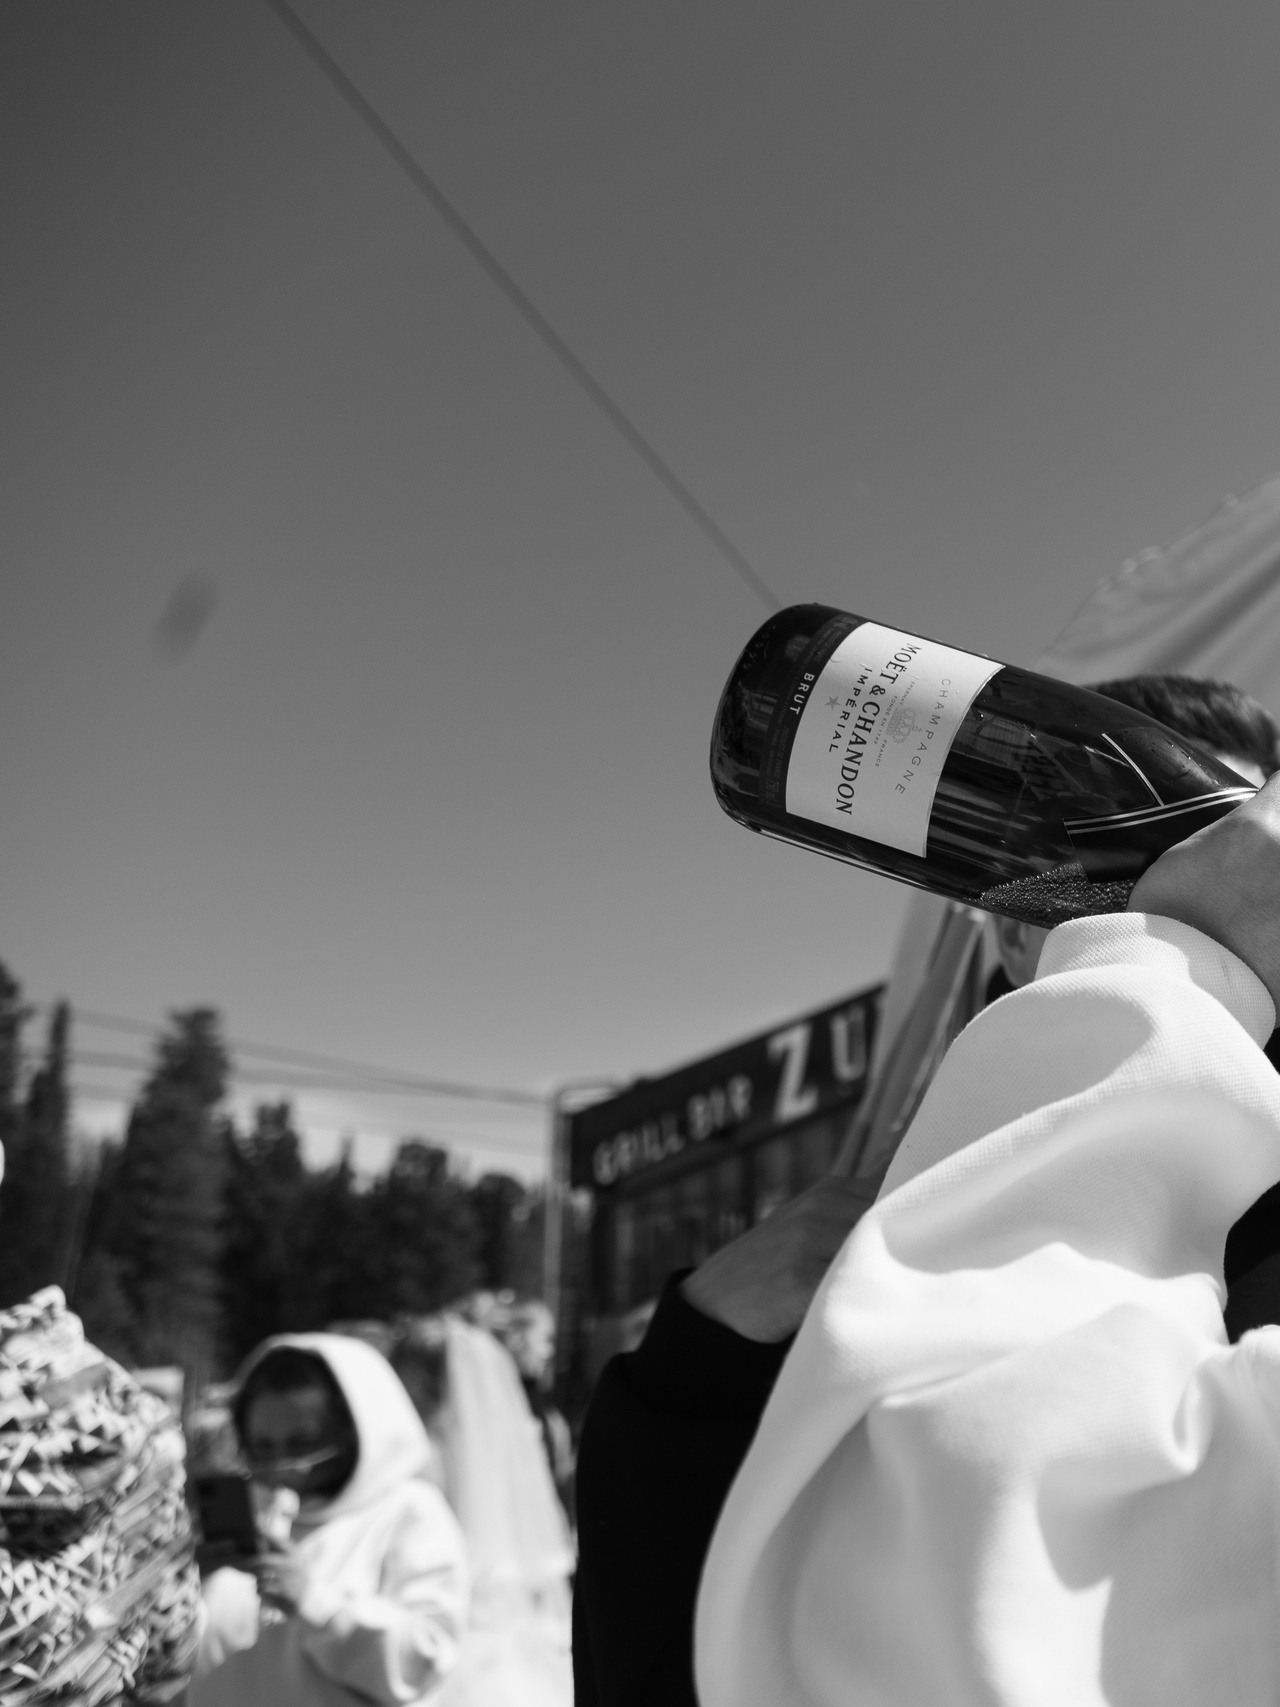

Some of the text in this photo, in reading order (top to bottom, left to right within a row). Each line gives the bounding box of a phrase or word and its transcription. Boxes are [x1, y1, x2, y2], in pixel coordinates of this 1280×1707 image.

[789, 672, 815, 715] BRUT
[829, 667, 872, 752] IMPÉRIAL
[835, 643, 922, 816] MOËT & CHANDON
[895, 678, 951, 794] CHAMPAGNE
